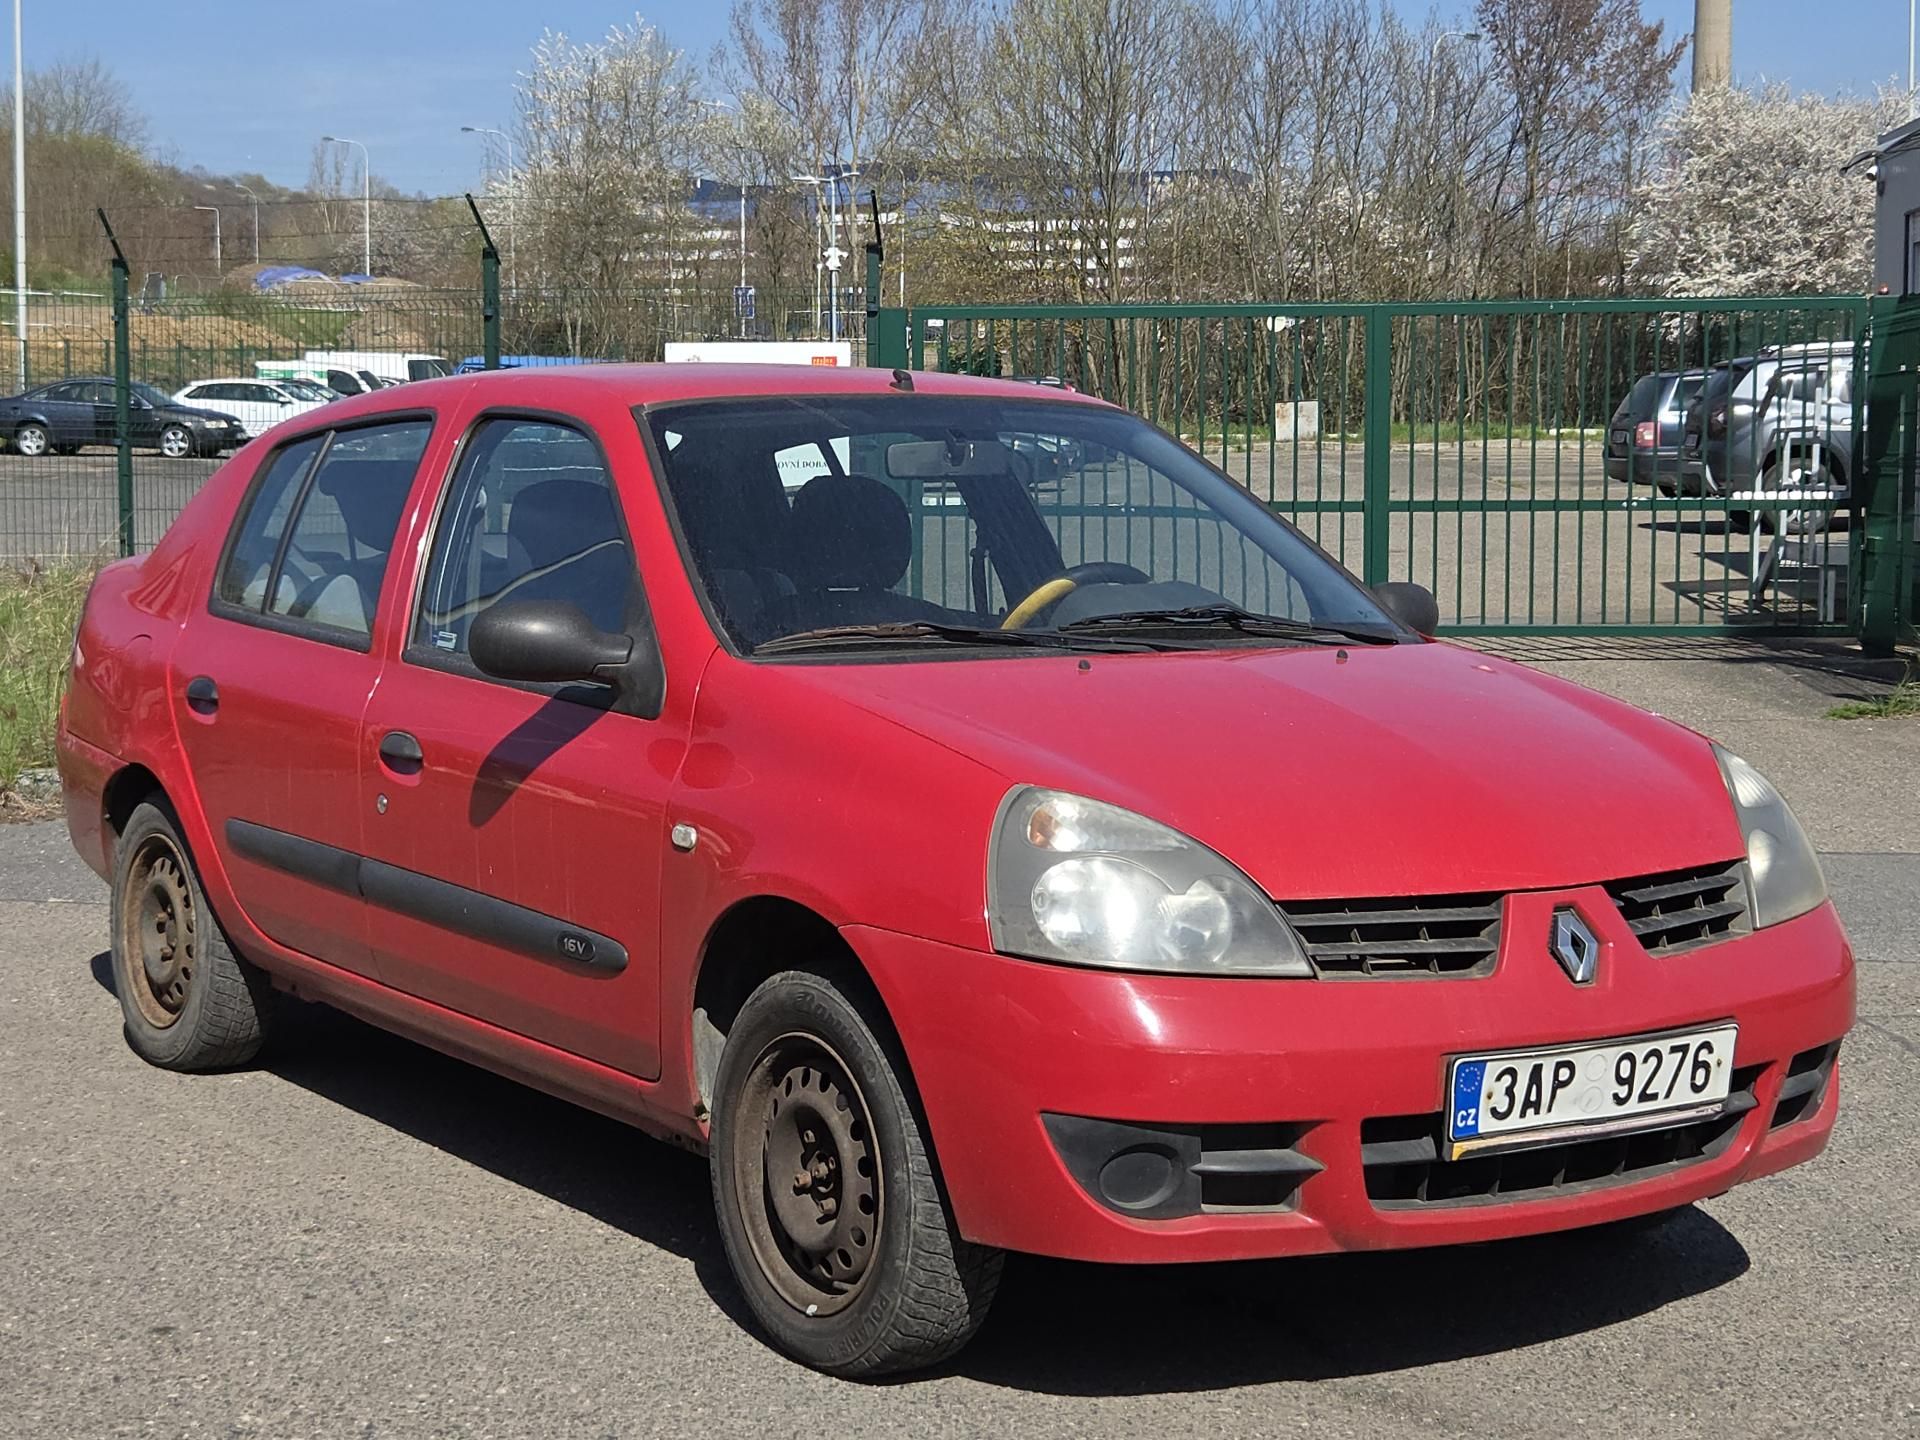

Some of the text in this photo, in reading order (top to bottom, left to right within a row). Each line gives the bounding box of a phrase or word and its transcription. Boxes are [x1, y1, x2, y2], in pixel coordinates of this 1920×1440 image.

[563, 937, 586, 955] 16V
[1489, 1040, 1715, 1121] 3AP 9276
[1456, 1108, 1477, 1128] CZ
